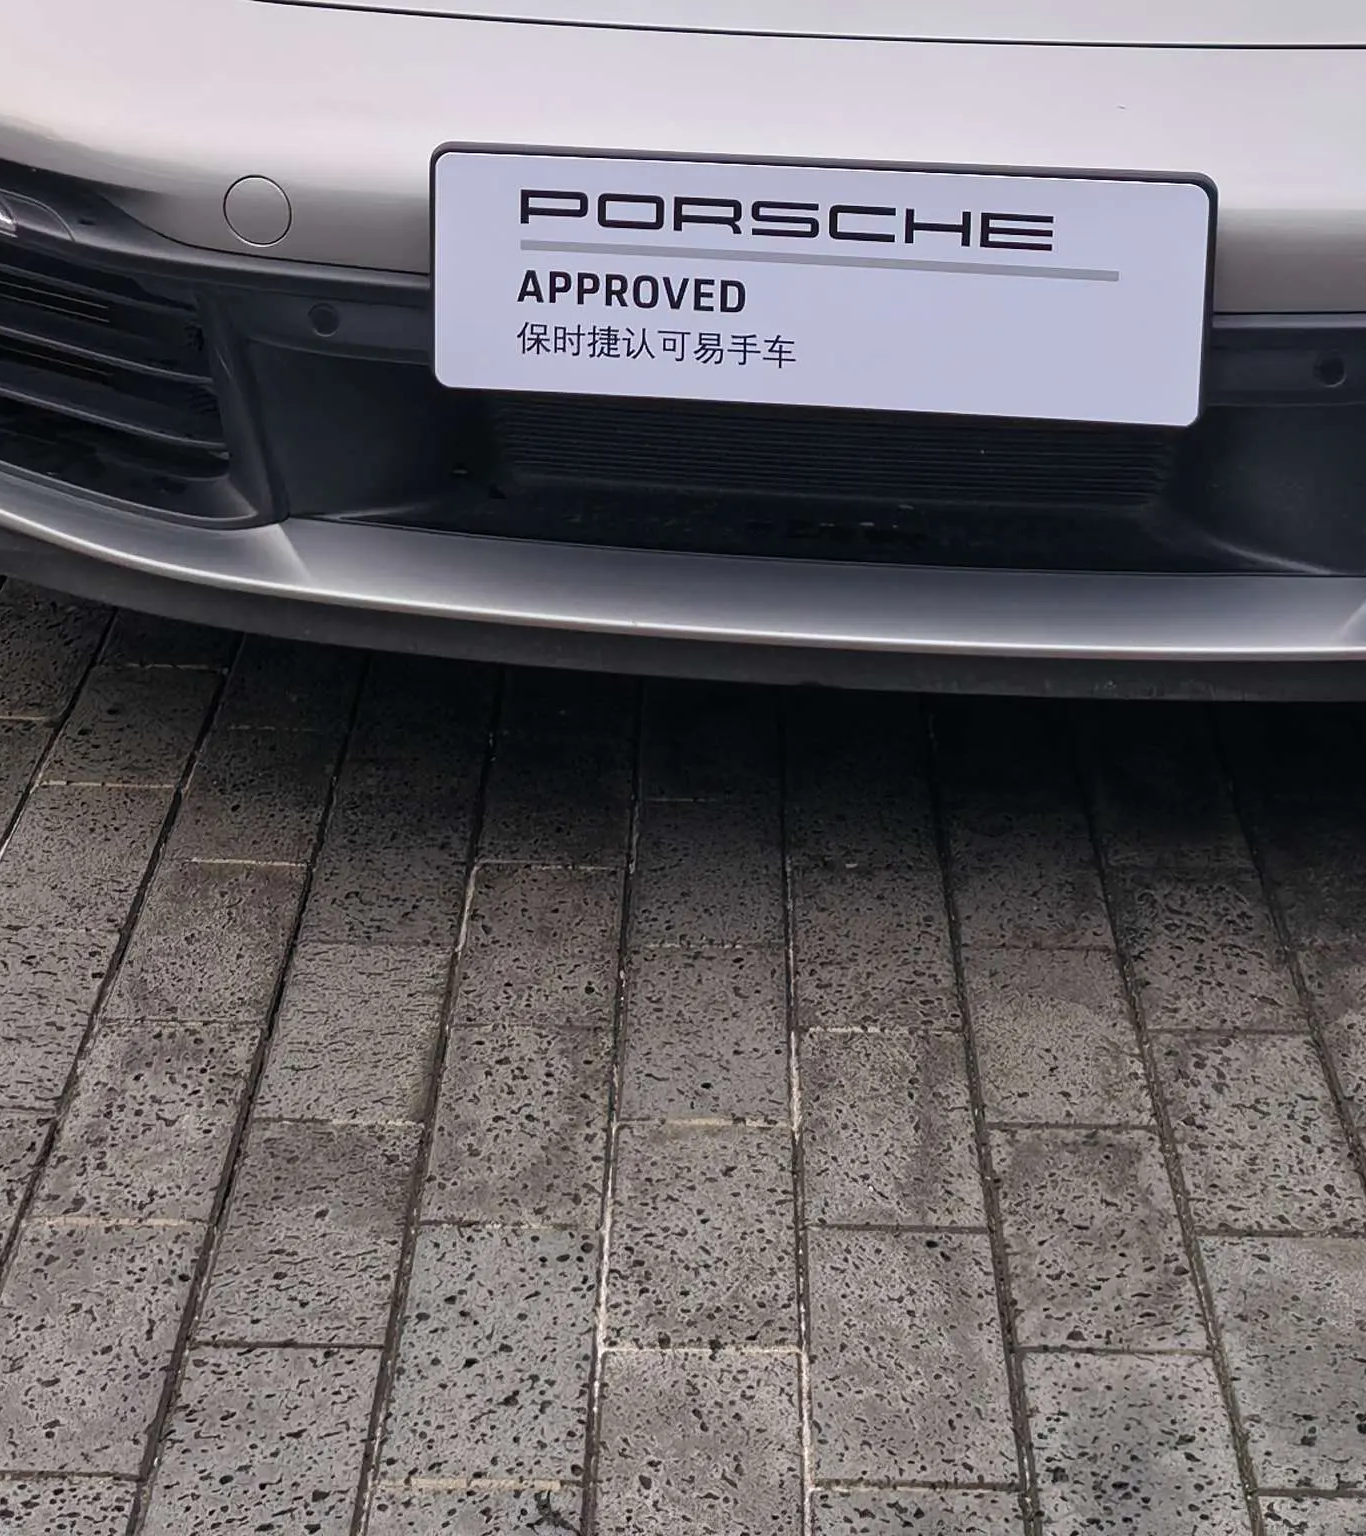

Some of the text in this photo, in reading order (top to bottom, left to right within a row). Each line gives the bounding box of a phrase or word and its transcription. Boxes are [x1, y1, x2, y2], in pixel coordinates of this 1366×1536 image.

[520, 189, 1054, 252] PORSCHE
[517, 270, 746, 313] APPROVED
[517, 321, 796, 369] 保时捷认可易手车
